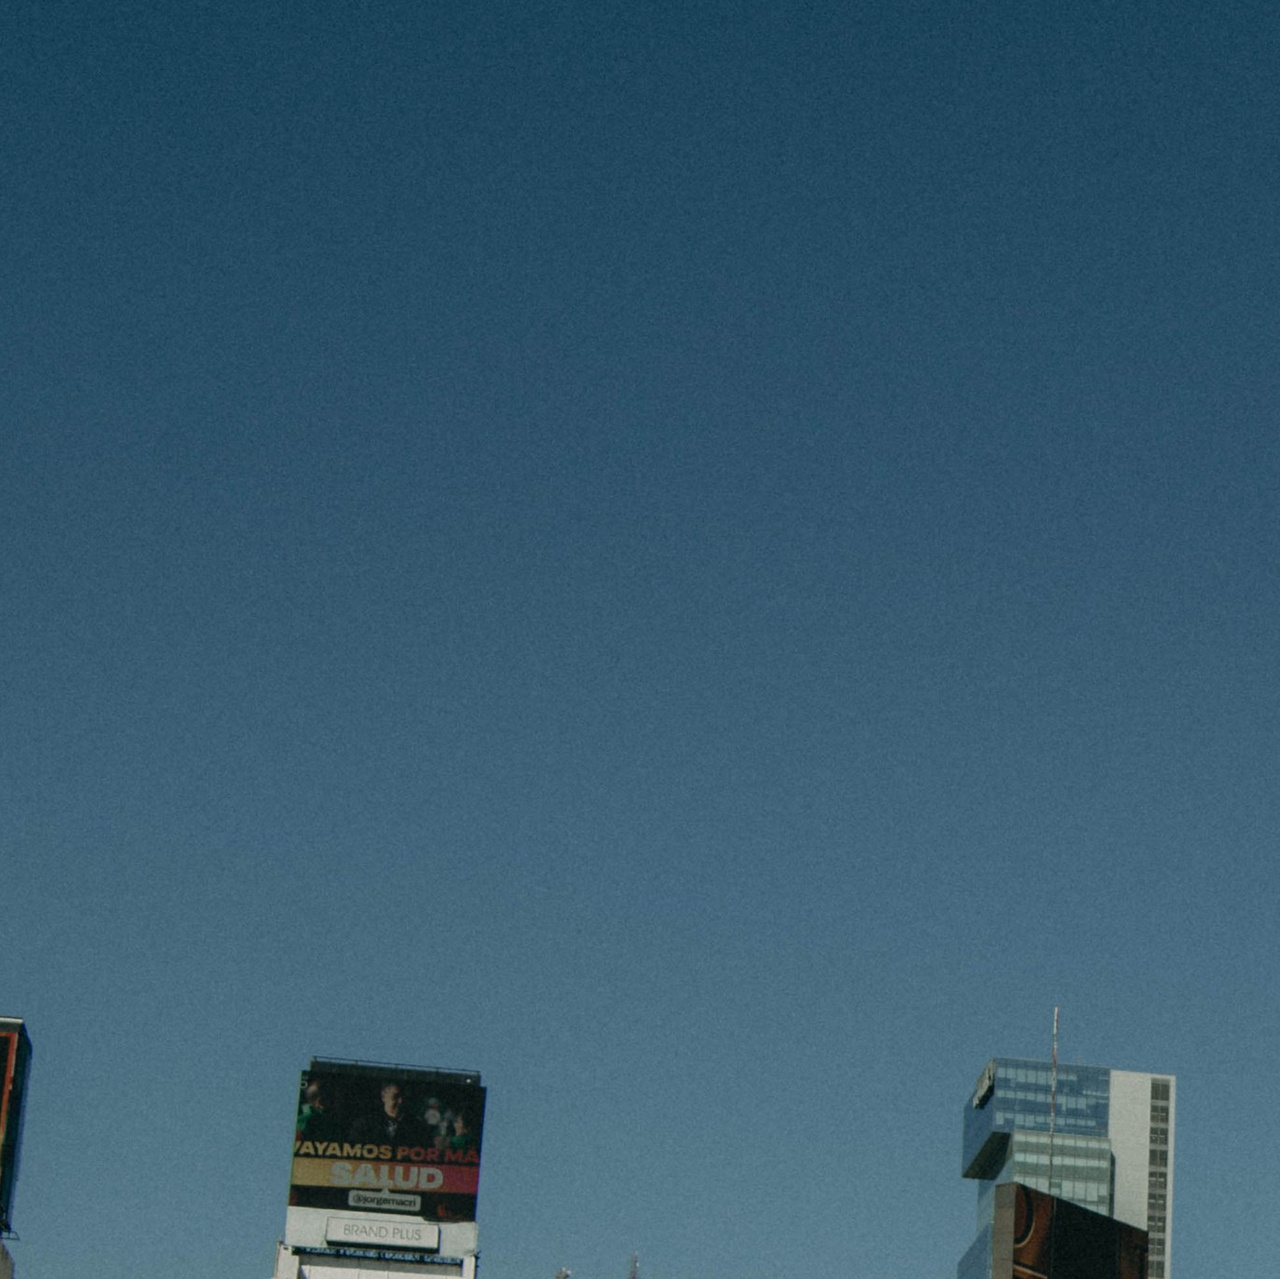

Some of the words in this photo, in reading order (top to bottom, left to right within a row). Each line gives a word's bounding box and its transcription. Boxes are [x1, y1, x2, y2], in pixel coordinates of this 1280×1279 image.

[395, 1145, 440, 1161] POR
[329, 1161, 444, 1190] SALUD
[352, 1193, 417, 1208] @jorgemacri
[343, 1223, 388, 1239] BRAND
[392, 1227, 422, 1240] PLUS
